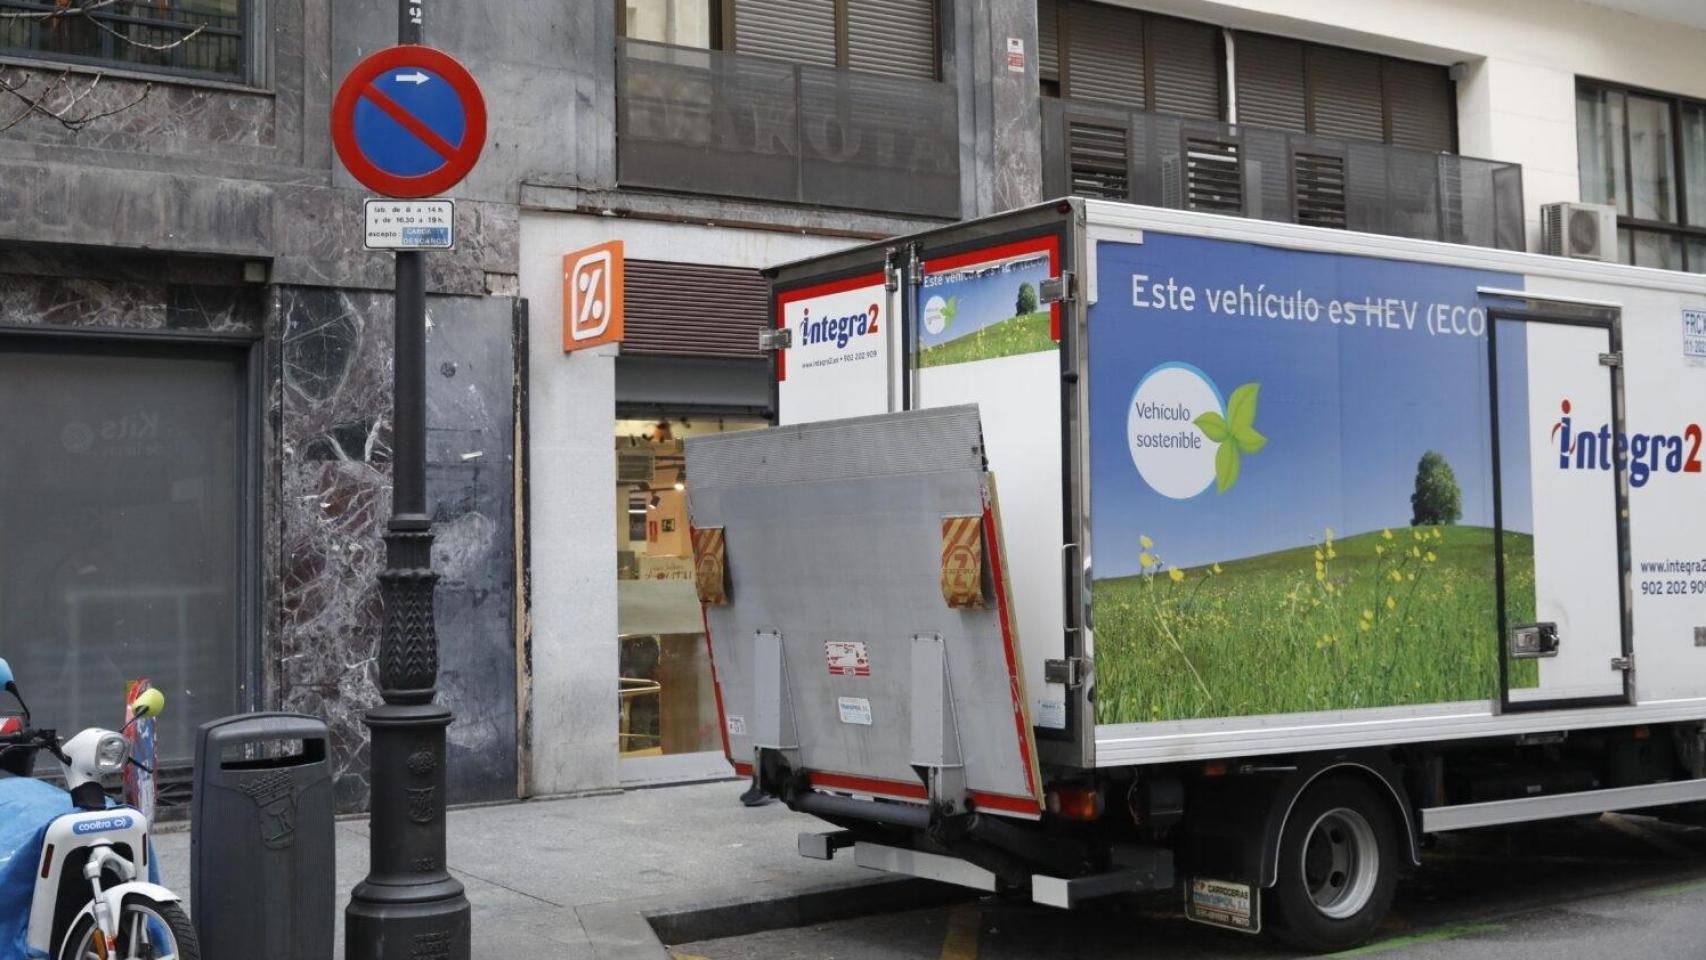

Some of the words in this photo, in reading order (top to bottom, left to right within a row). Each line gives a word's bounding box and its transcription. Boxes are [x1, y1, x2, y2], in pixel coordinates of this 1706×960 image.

[1132, 274, 1196, 312] Este
[1206, 284, 1319, 322] vehículo
[1328, 300, 1357, 326] es
[1366, 297, 1419, 331] HEV
[1427, 303, 1488, 337] (ECO
[800, 302, 879, 349] integra2
[1135, 401, 1191, 421] Vehículo
[1136, 431, 1202, 449] sostenible
[1551, 399, 1702, 488] integra2
[1641, 581, 1663, 595] 902
[1666, 580, 1687, 595] 202
[79, 820, 112, 832] cooltra
